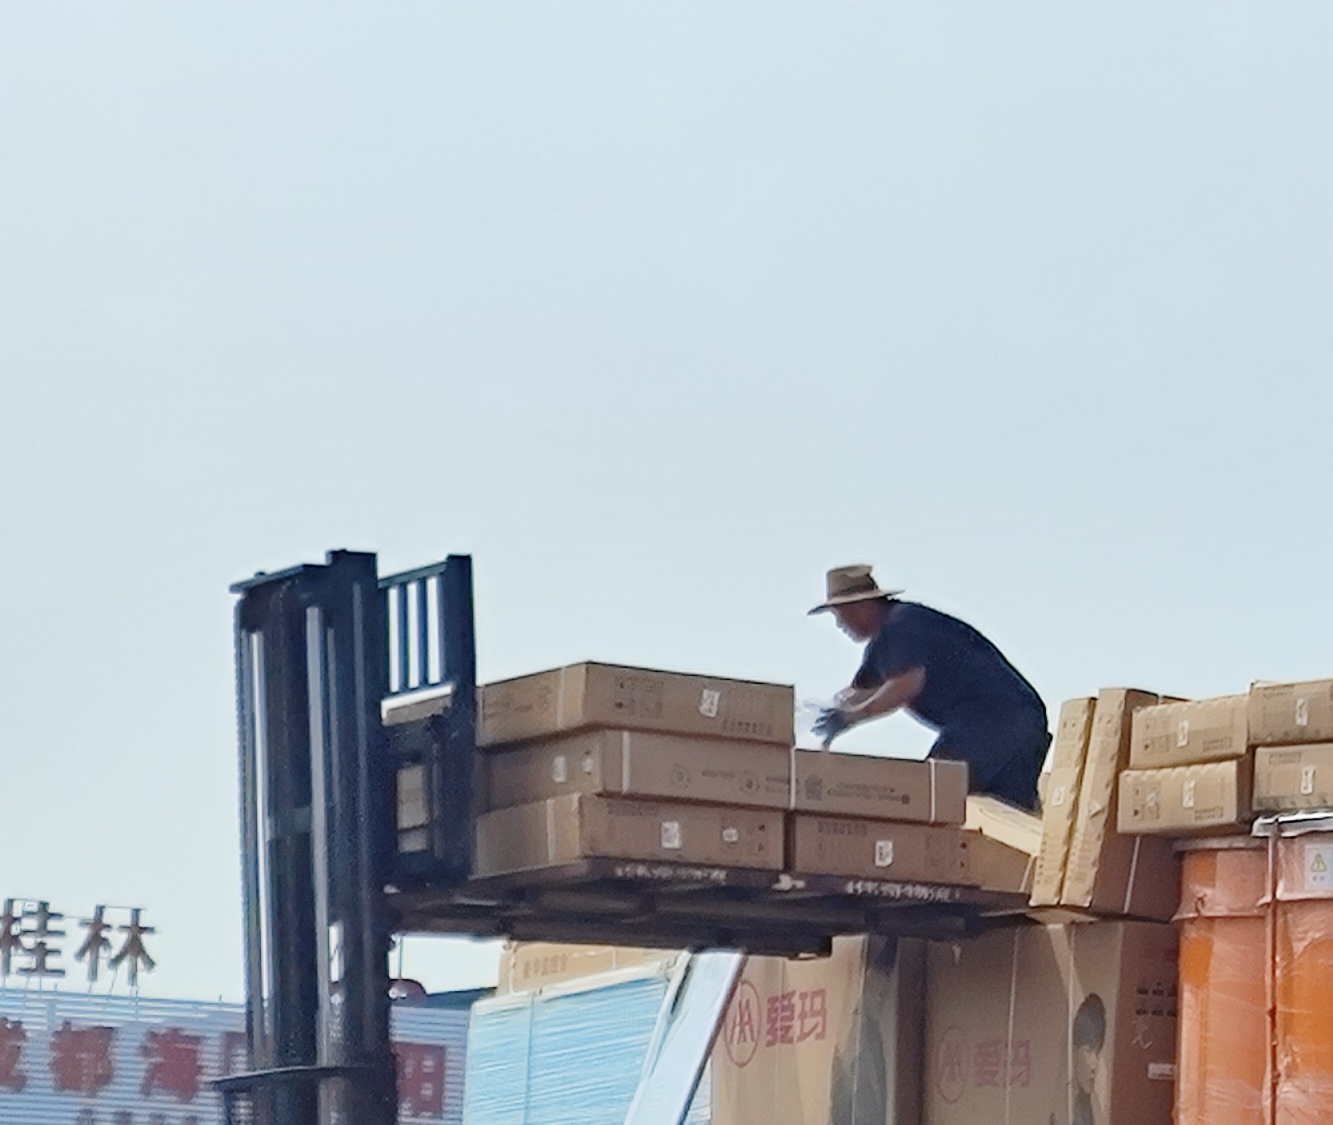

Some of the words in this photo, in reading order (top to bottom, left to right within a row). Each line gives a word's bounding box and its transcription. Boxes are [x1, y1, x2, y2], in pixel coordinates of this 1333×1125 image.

[0, 898, 157, 987] 桂林
[765, 988, 828, 1048] 爱玛
[974, 1039, 1031, 1088] 爱玛
